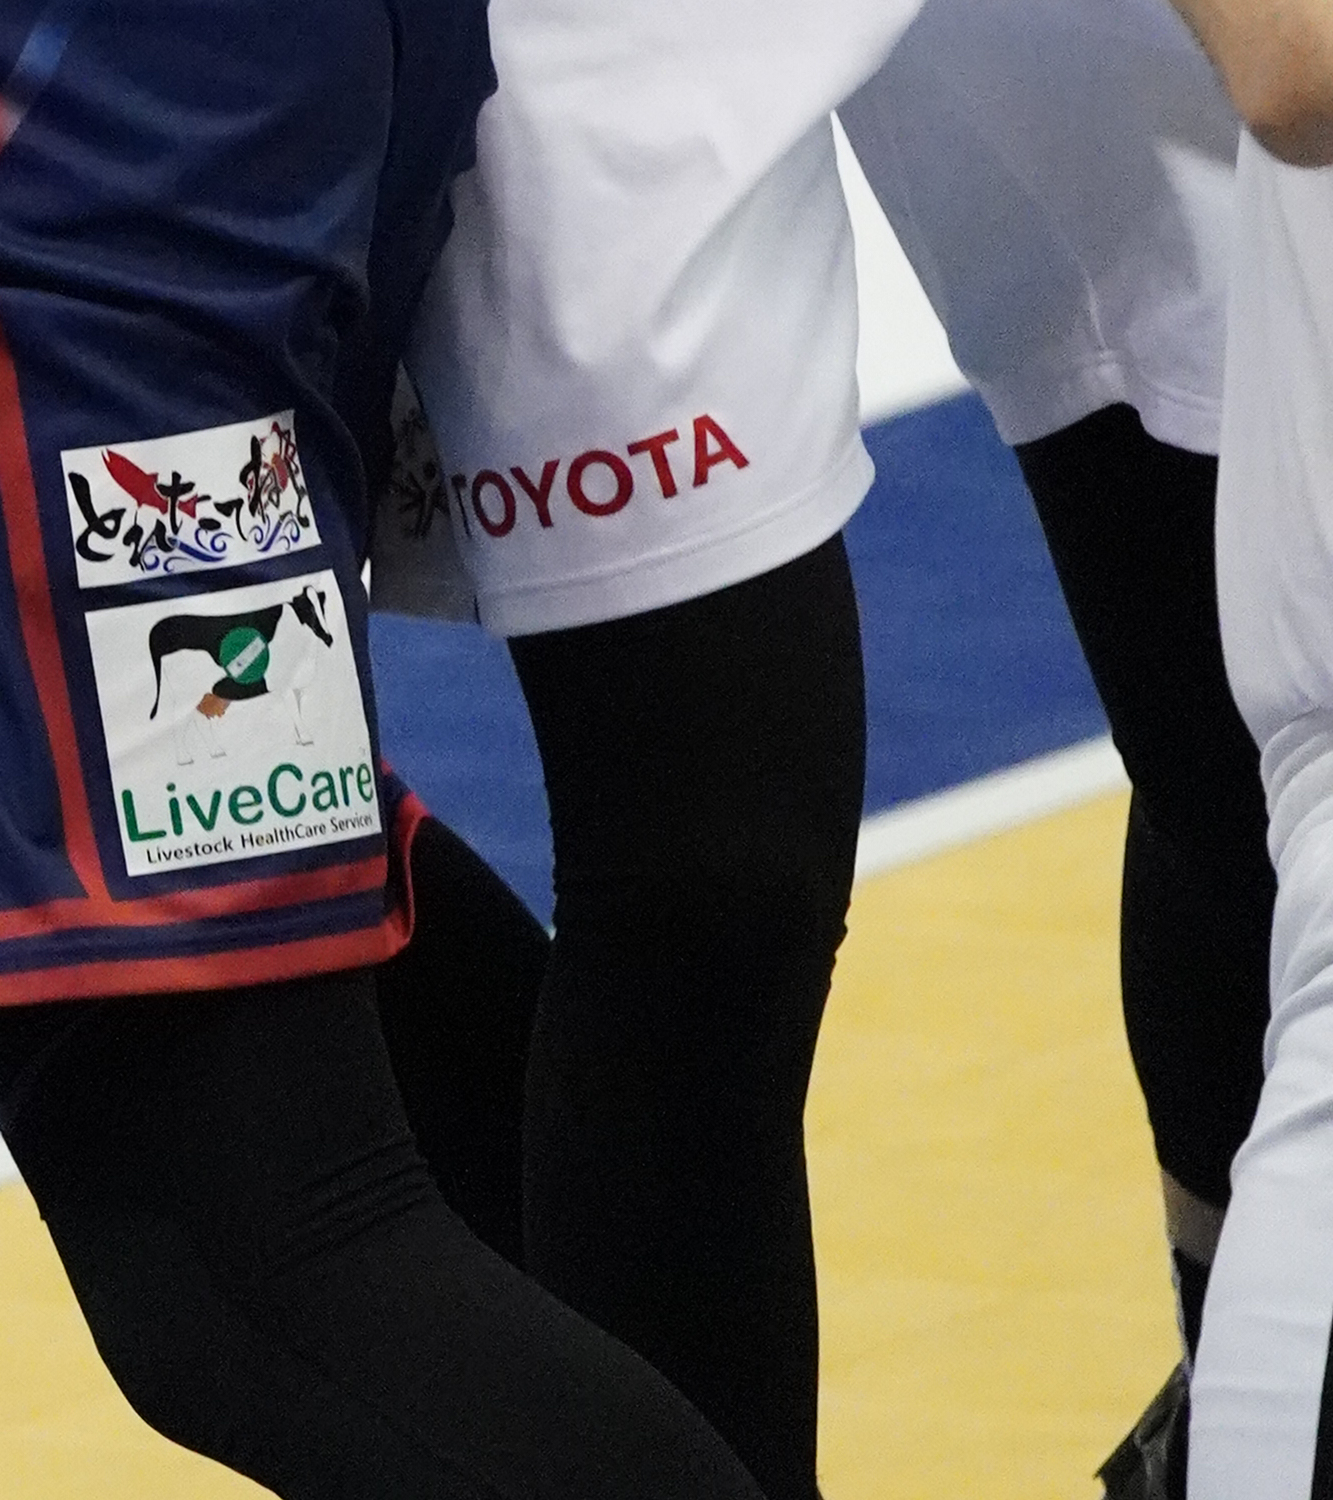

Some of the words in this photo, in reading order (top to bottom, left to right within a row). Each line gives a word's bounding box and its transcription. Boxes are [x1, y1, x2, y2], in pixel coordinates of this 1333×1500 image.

[121, 762, 375, 843] LiveCare
[146, 836, 234, 865] Livestock
[240, 816, 327, 849] HealthCare
